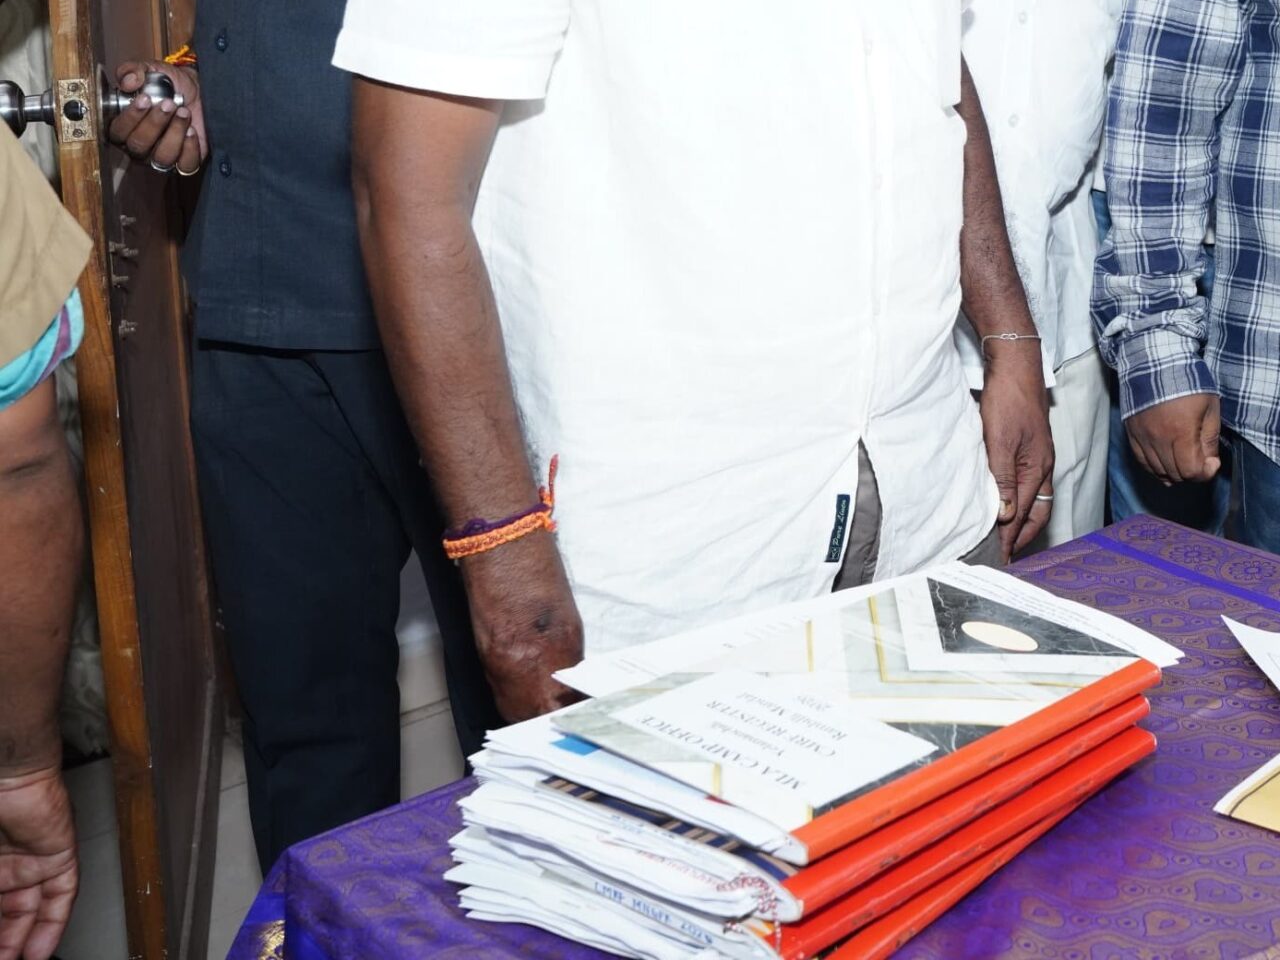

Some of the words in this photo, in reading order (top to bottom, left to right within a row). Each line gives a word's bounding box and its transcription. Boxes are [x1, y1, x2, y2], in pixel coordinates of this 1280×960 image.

[635, 713, 703, 748] OFFICE
[706, 700, 786, 738] REGISTER
[701, 742, 759, 770] CAMP
[759, 765, 804, 790] MLA
